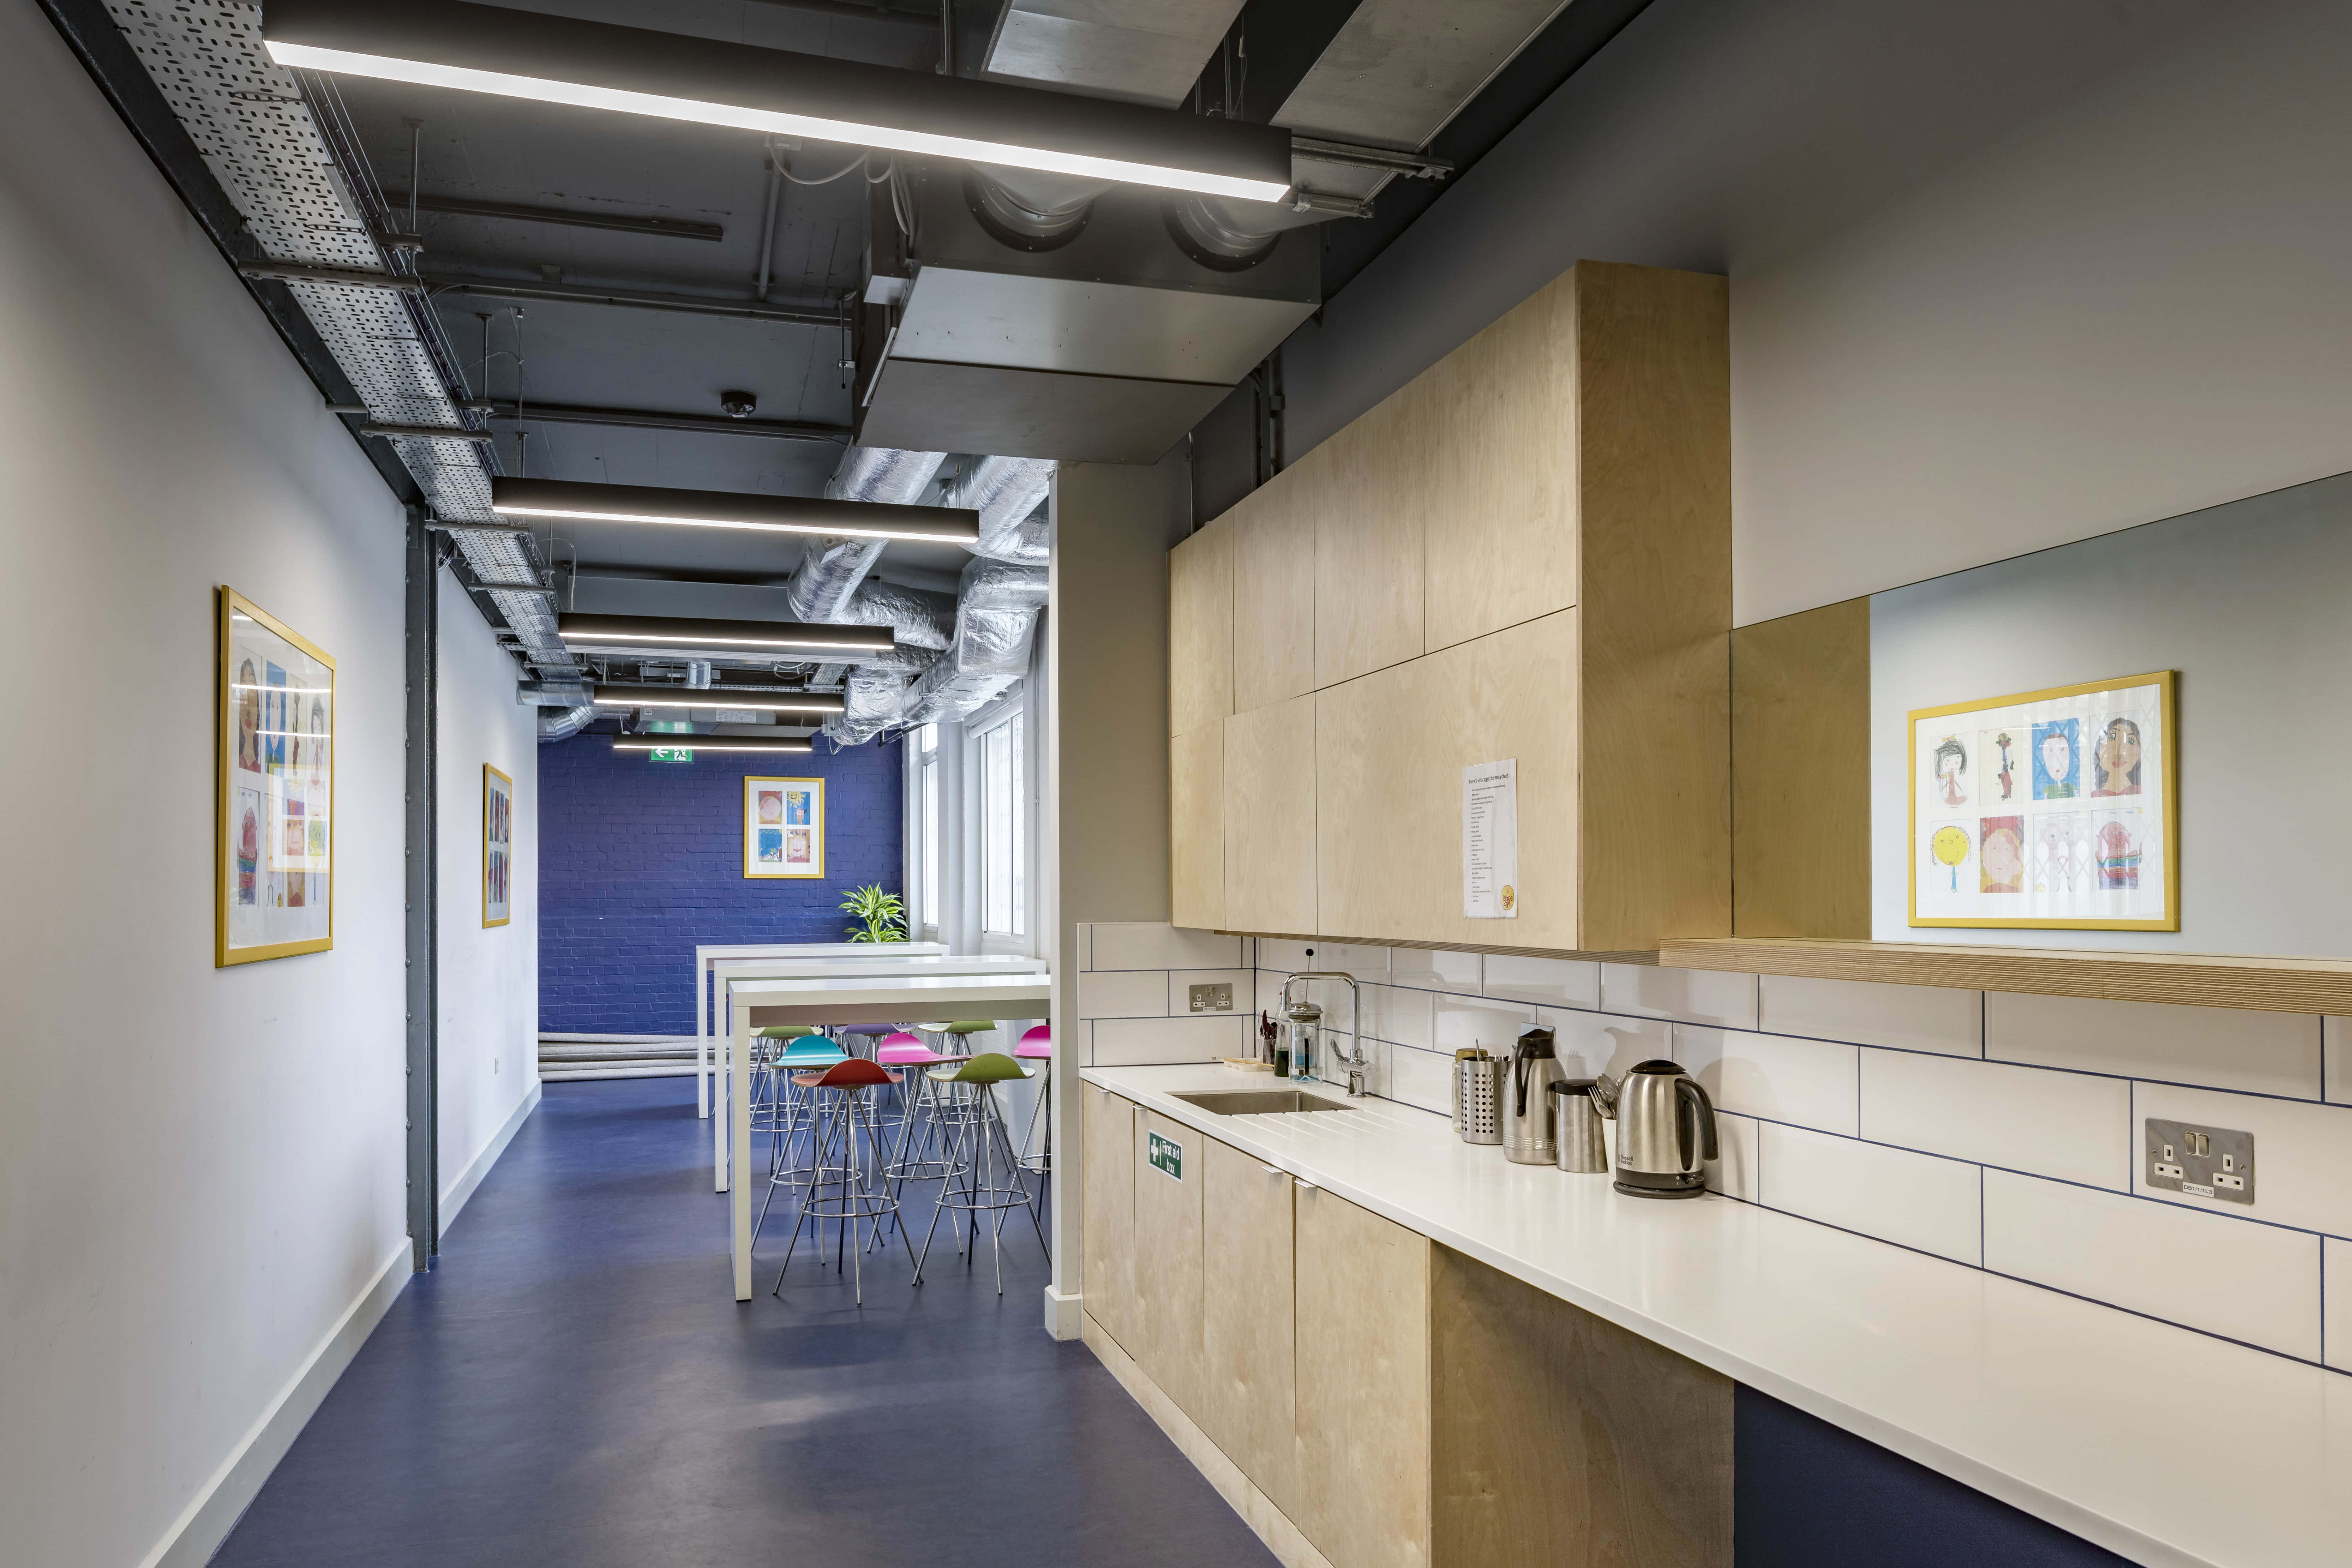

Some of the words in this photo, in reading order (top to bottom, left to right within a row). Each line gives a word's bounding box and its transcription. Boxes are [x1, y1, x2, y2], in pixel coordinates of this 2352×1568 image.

[1162, 1140, 1172, 1157] First
[1166, 1158, 1175, 1175] box
[2184, 1184, 2213, 1194] DB1/1/1L3
